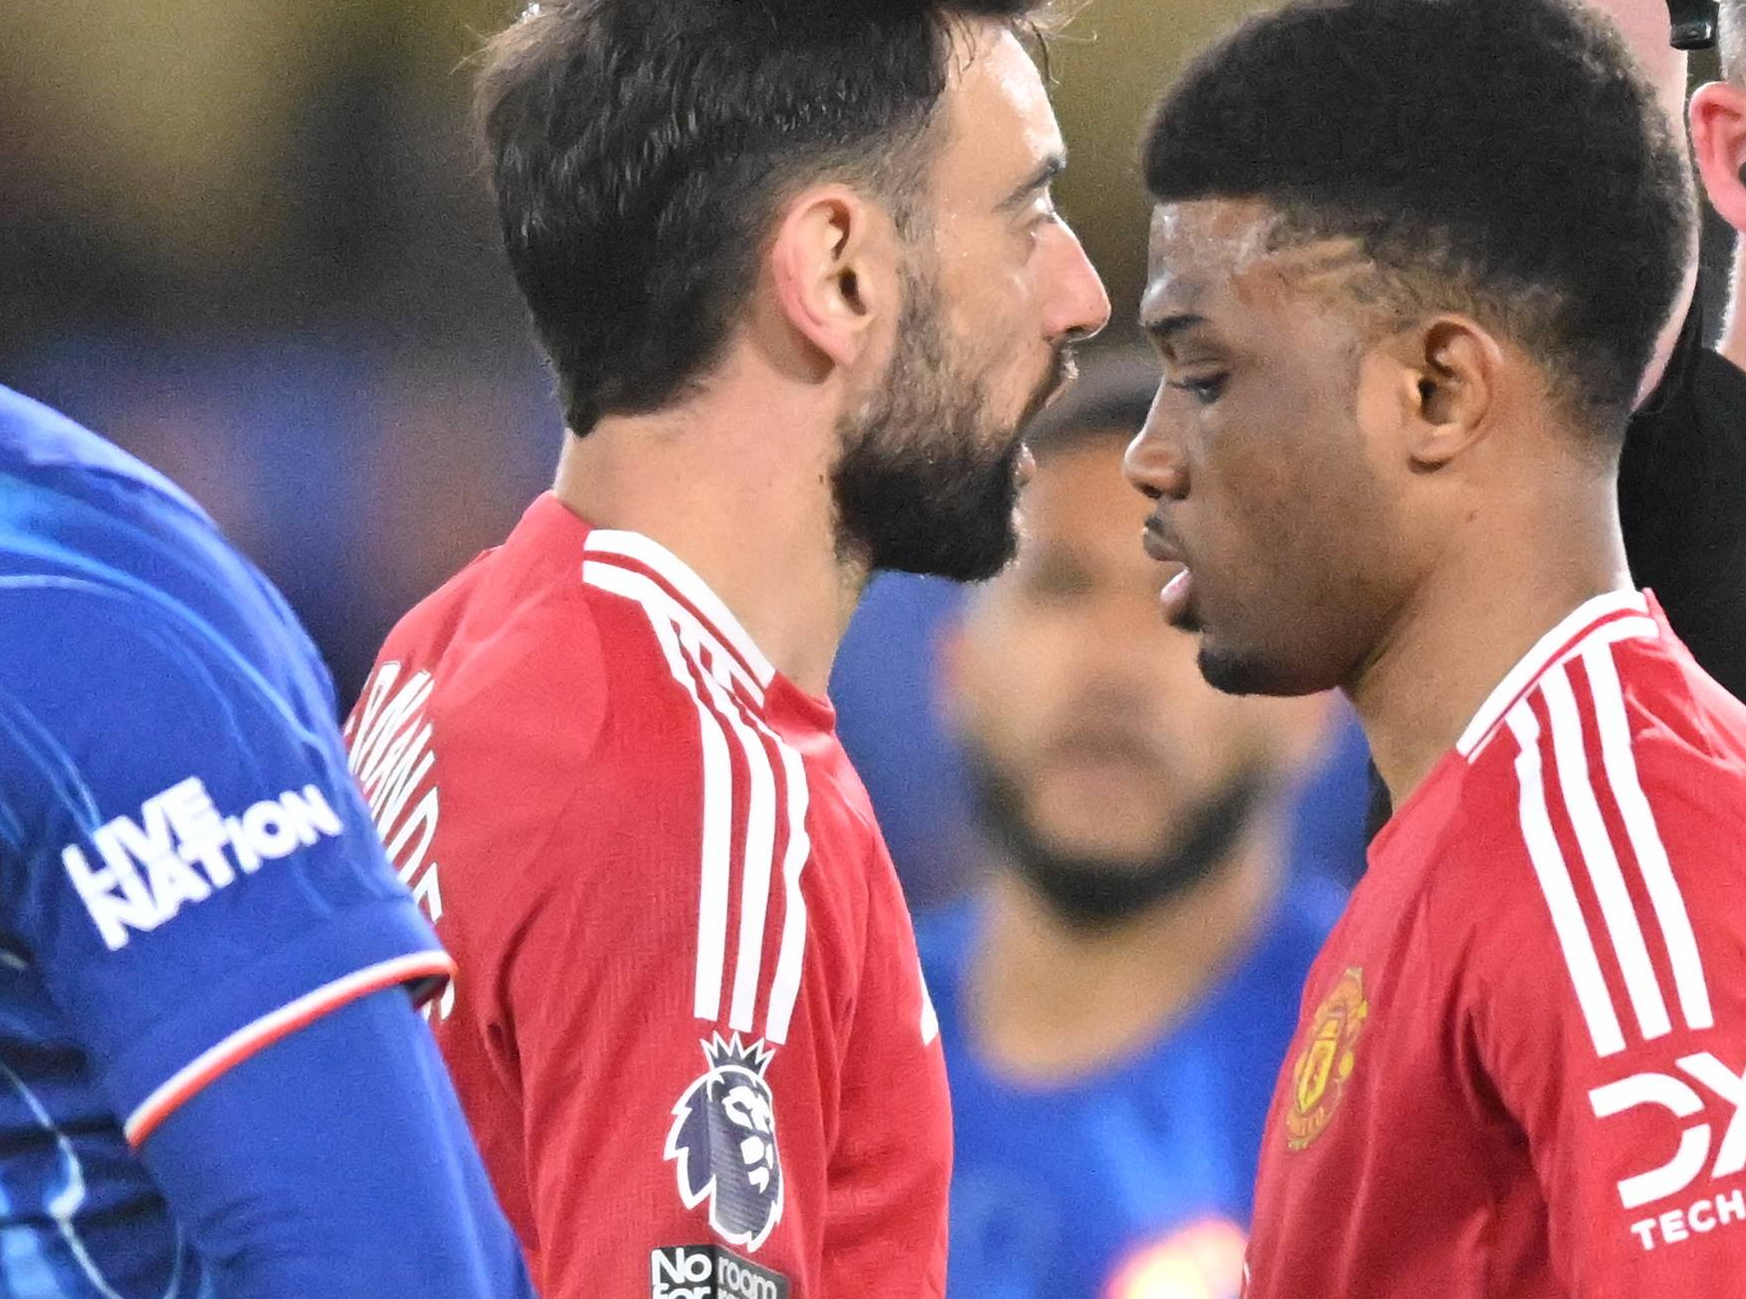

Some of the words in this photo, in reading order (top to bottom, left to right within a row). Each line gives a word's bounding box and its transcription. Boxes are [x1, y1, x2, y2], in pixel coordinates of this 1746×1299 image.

[61, 775, 220, 896] LIVE
[83, 782, 345, 951] NATION
[650, 1246, 713, 1284] No
